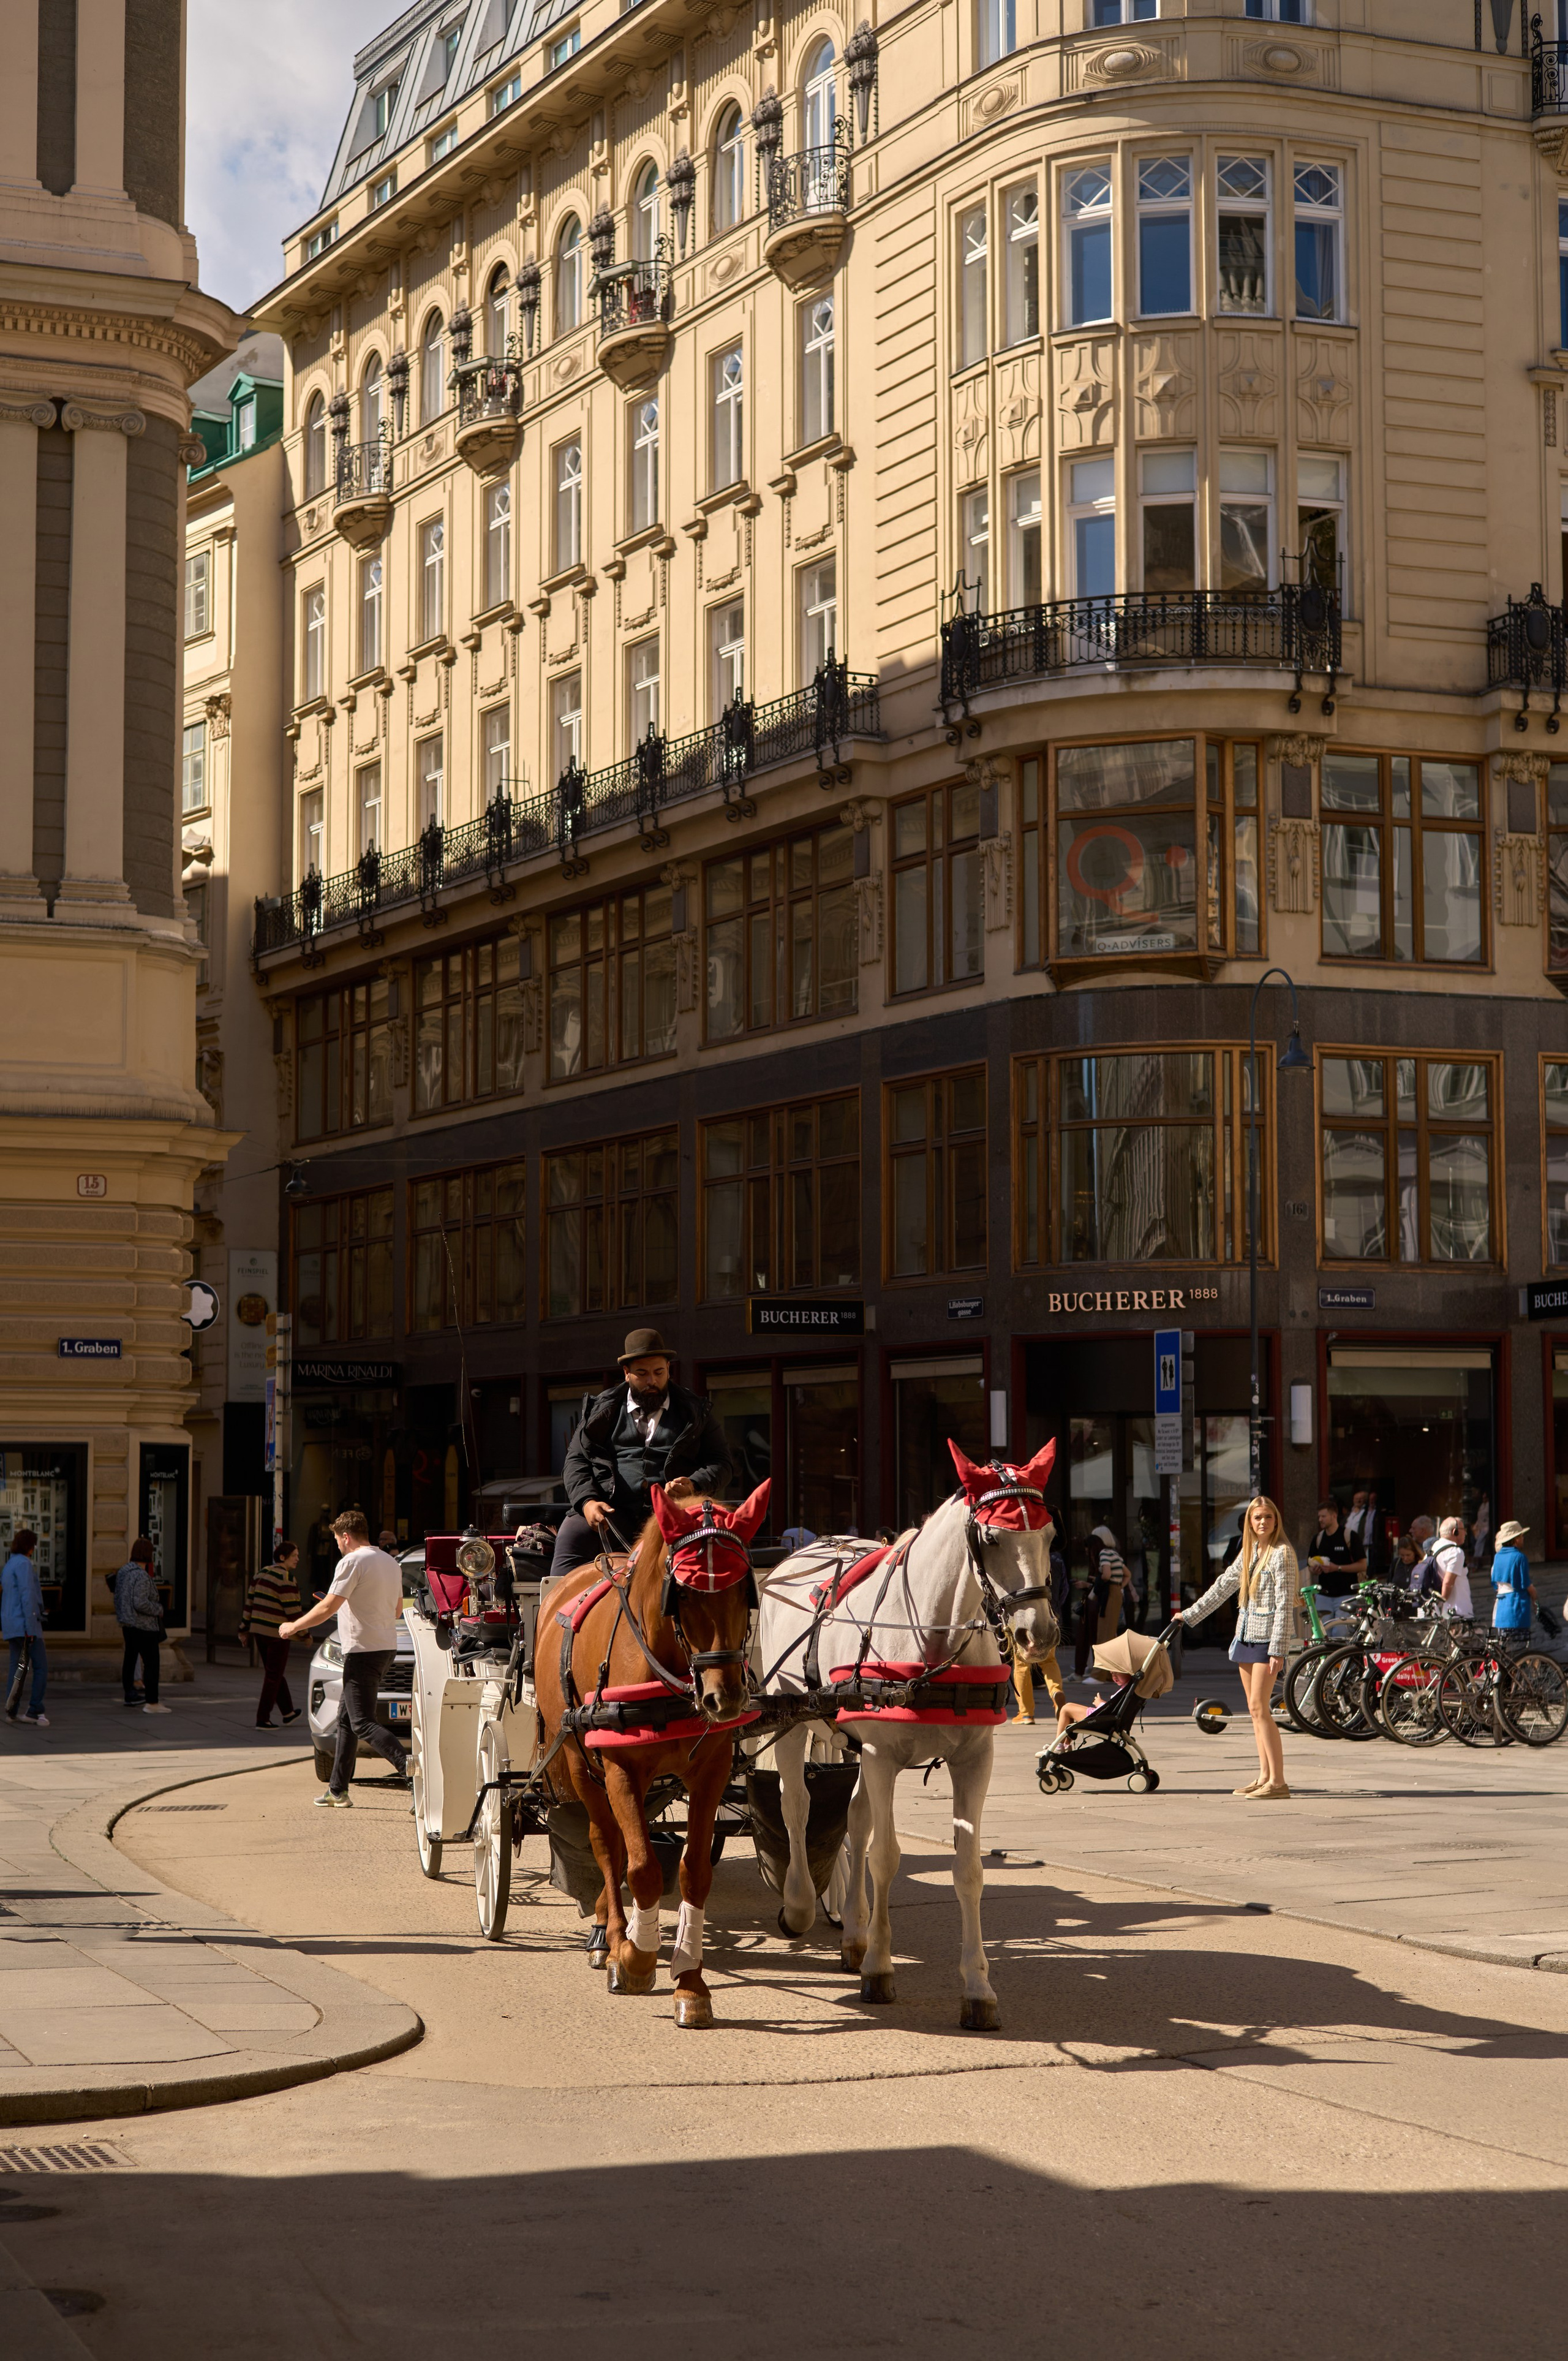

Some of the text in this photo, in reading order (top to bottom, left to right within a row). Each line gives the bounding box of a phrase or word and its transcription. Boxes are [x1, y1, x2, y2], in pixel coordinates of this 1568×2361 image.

[84, 1176, 99, 1189] 15
[1048, 1288, 1218, 1312] BUCHERER 1888
[760, 1310, 840, 1324] BUCHERER
[74, 1341, 118, 1354] Graben
[298, 1364, 392, 1380] MARINA RINALDI
[399, 1704, 407, 1717] W
